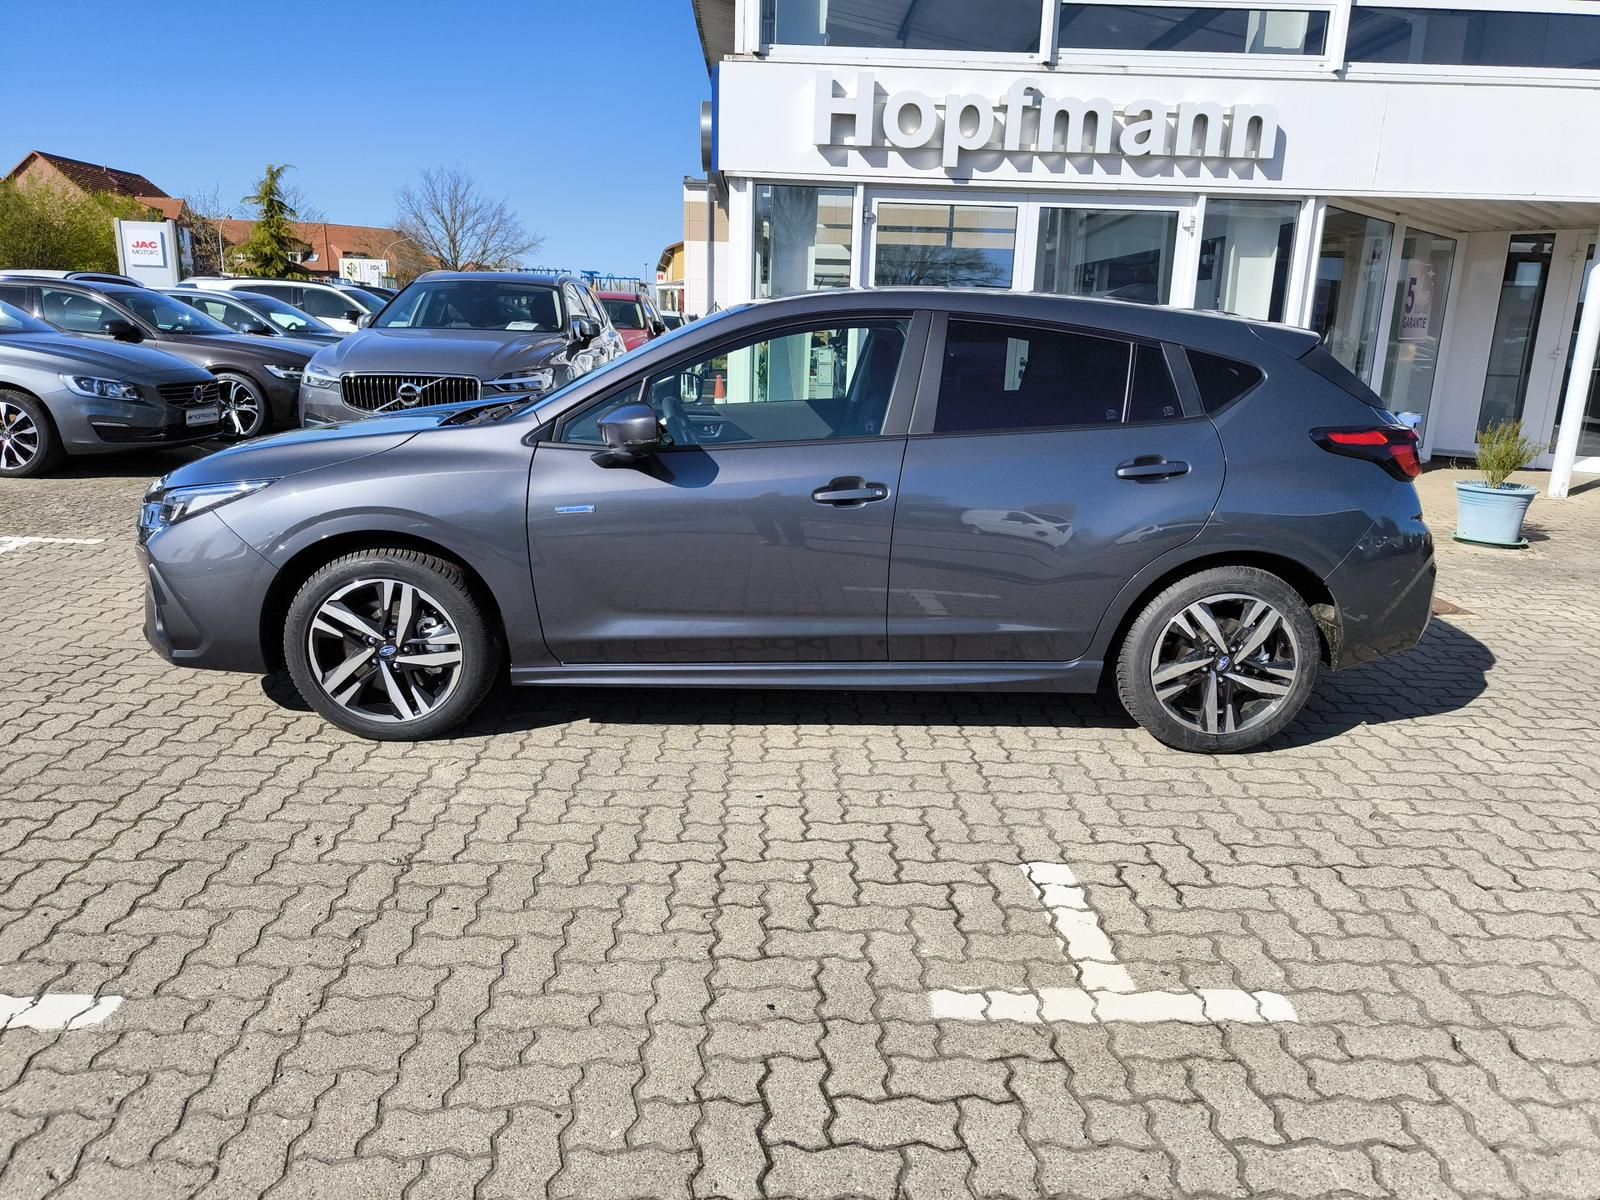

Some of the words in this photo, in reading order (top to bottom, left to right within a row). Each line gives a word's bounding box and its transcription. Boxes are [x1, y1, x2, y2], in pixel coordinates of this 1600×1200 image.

[813, 70, 1278, 168] Hopfmann
[131, 241, 158, 249] JAC
[1405, 277, 1417, 314] 5
